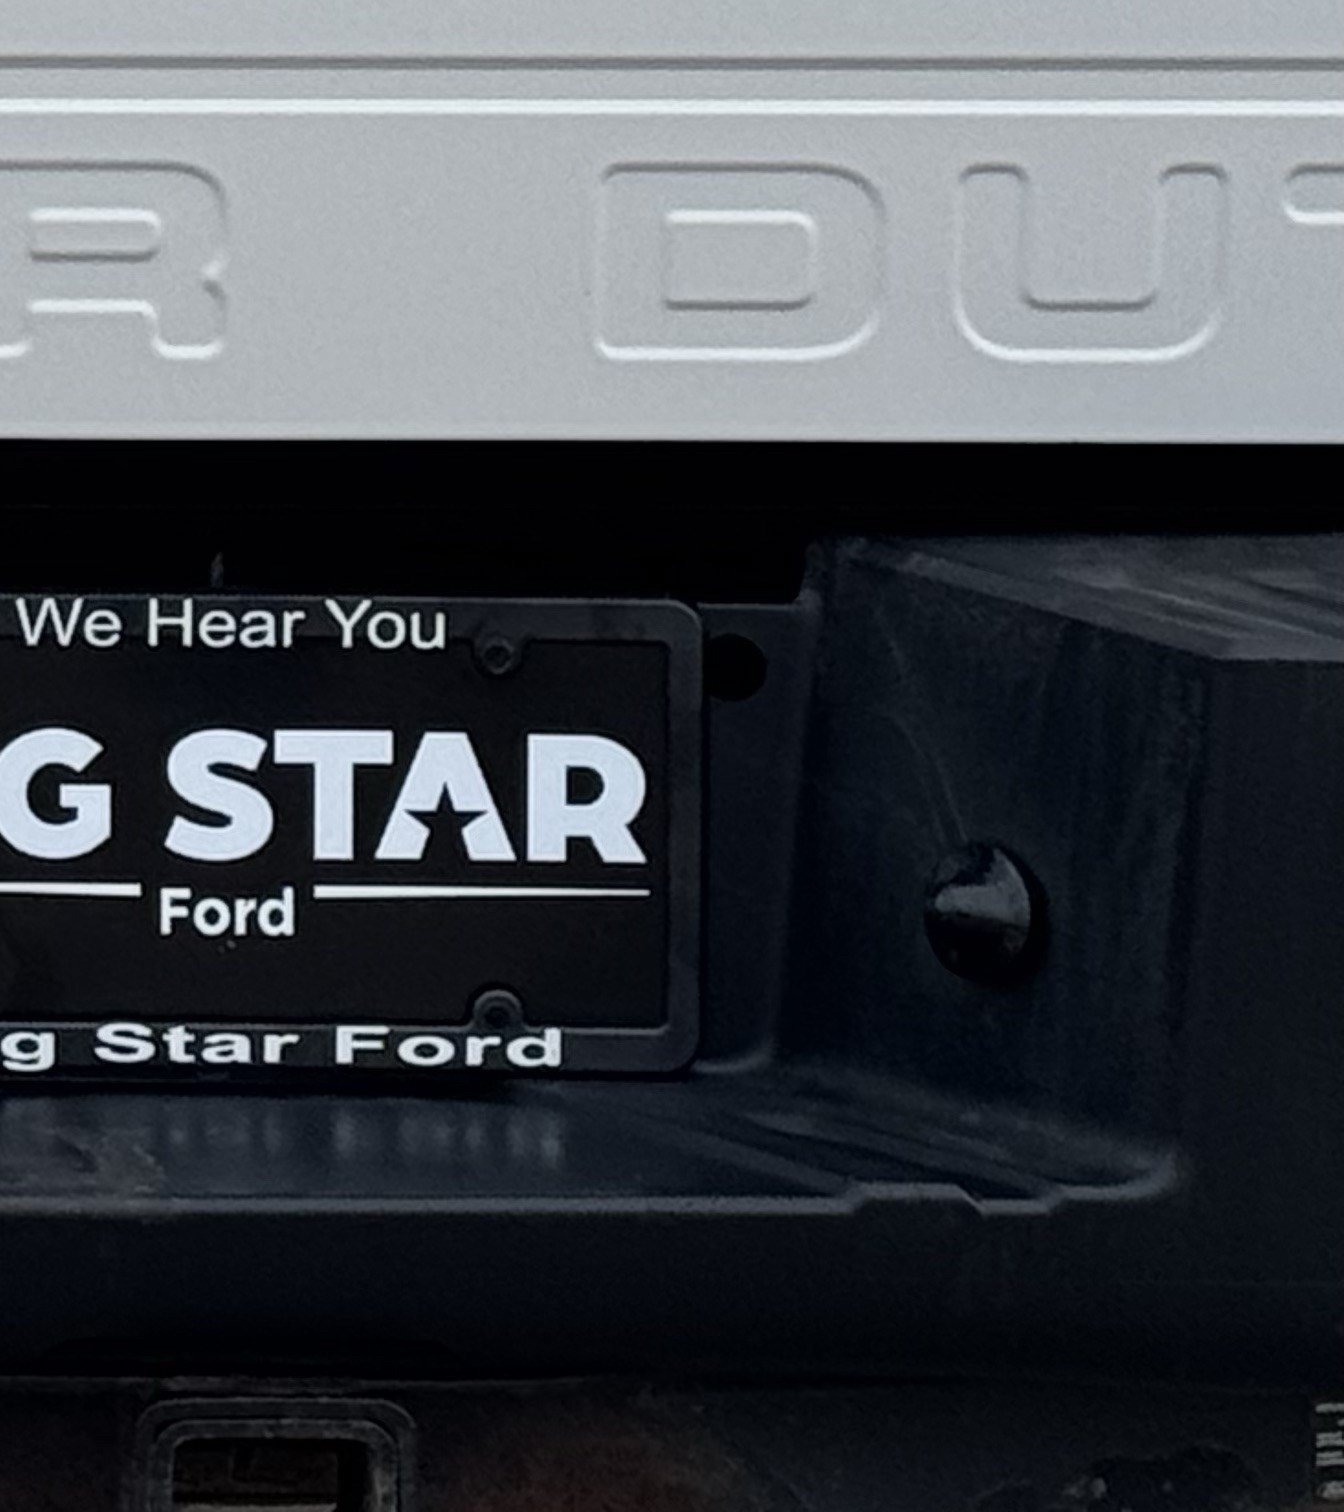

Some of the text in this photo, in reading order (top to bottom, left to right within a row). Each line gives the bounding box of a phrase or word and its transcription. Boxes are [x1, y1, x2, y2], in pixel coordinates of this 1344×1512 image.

[592, 159, 1344, 364] DU
[16, 597, 446, 650] We Hear You
[164, 728, 647, 864] STAR
[159, 885, 295, 937] Ford
[94, 1021, 300, 1064] Star
[335, 1024, 562, 1068] Ford
